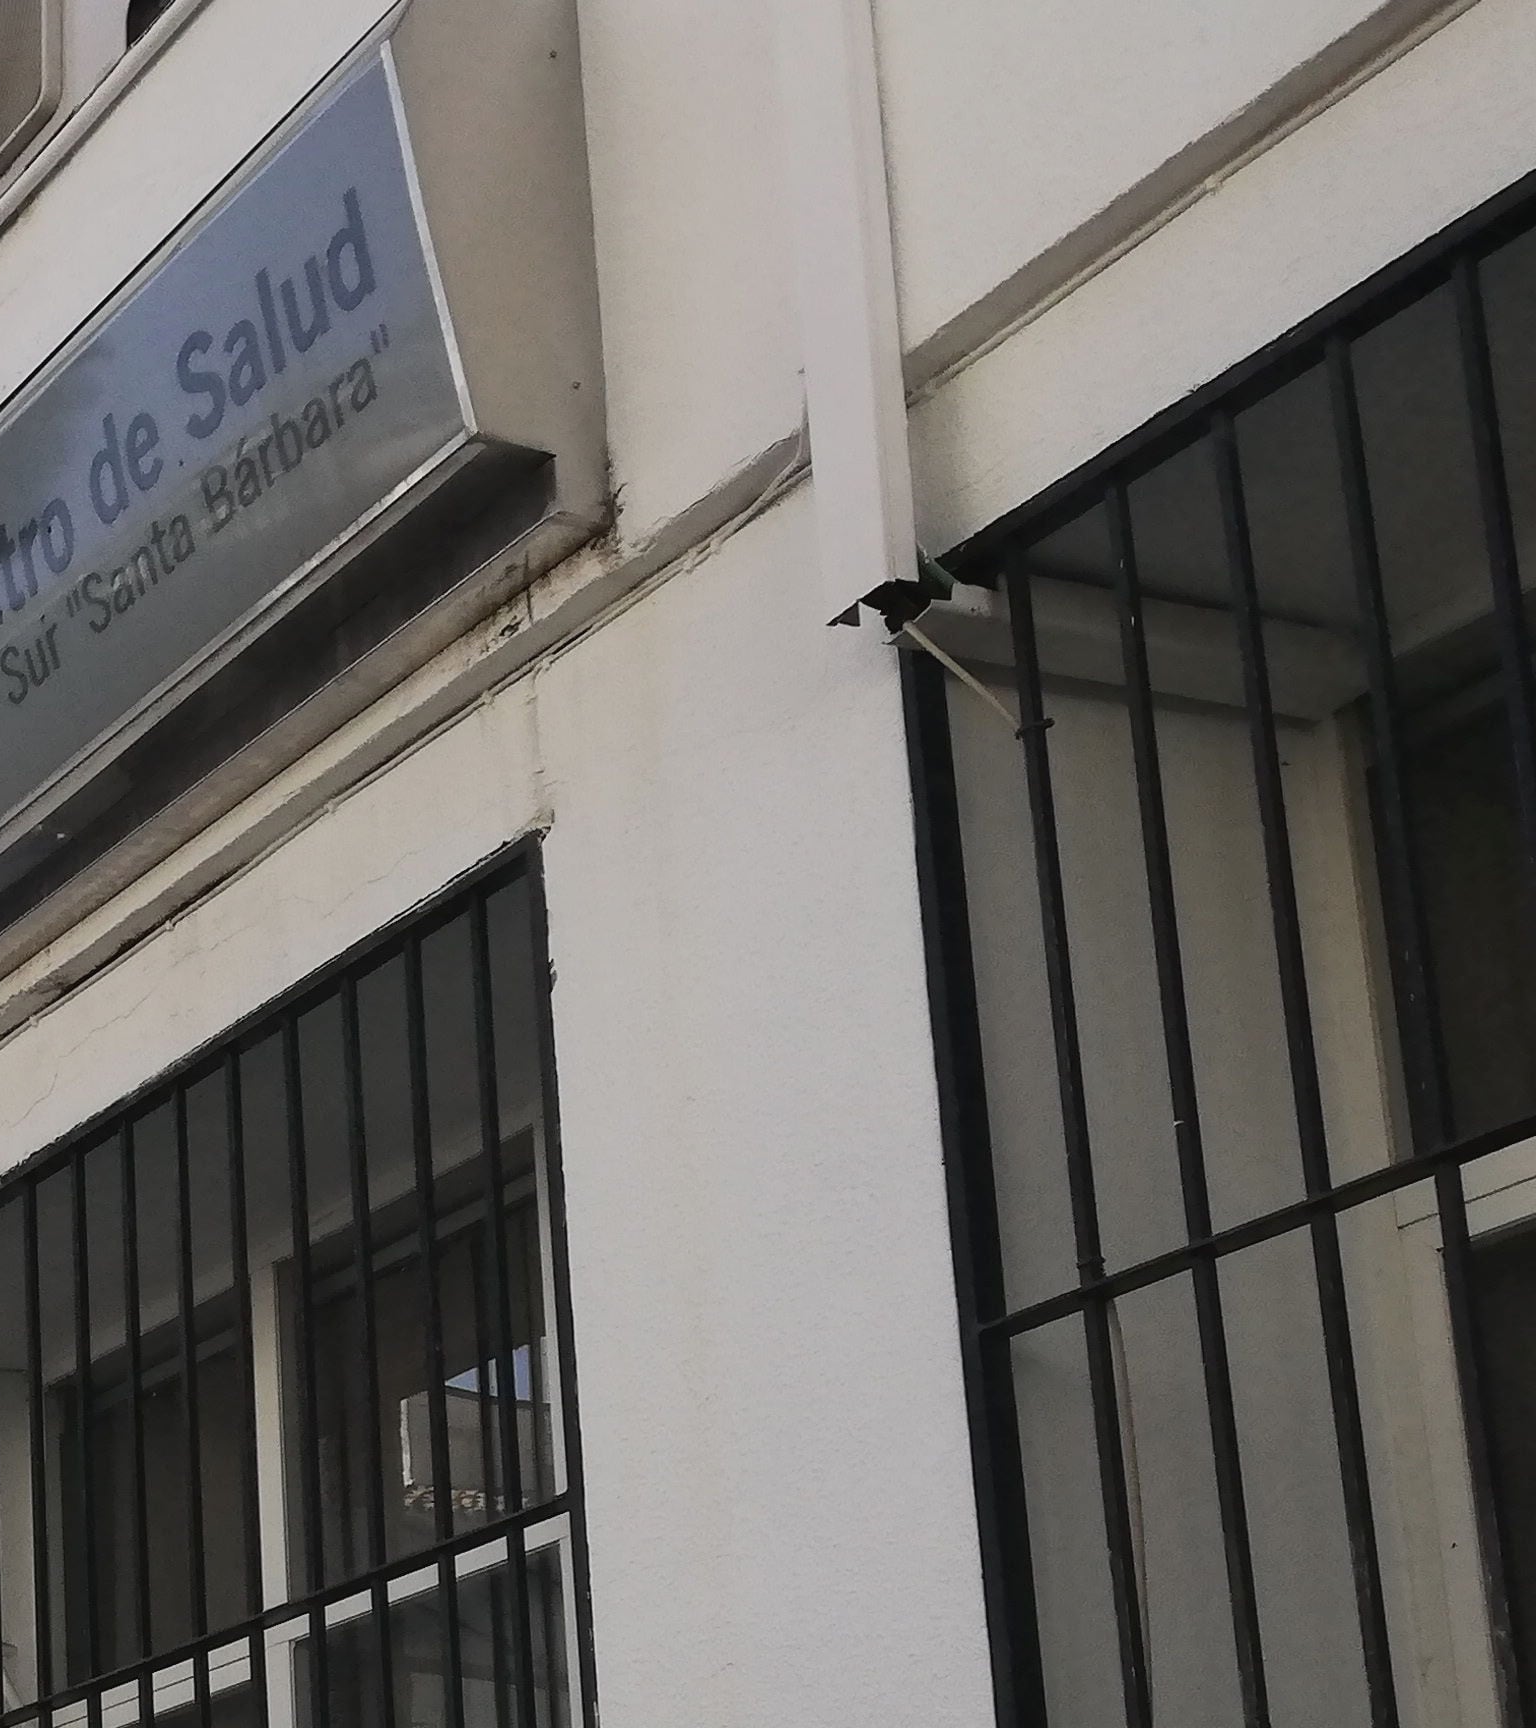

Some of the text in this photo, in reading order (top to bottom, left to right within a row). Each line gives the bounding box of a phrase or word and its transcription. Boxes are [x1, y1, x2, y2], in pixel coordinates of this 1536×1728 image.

[0, 622, 61, 705] Sur
[65, 512, 196, 634] "Santa
[200, 322, 390, 535] Bárbara"
[89, 411, 164, 525] de
[175, 185, 377, 440] Salud
